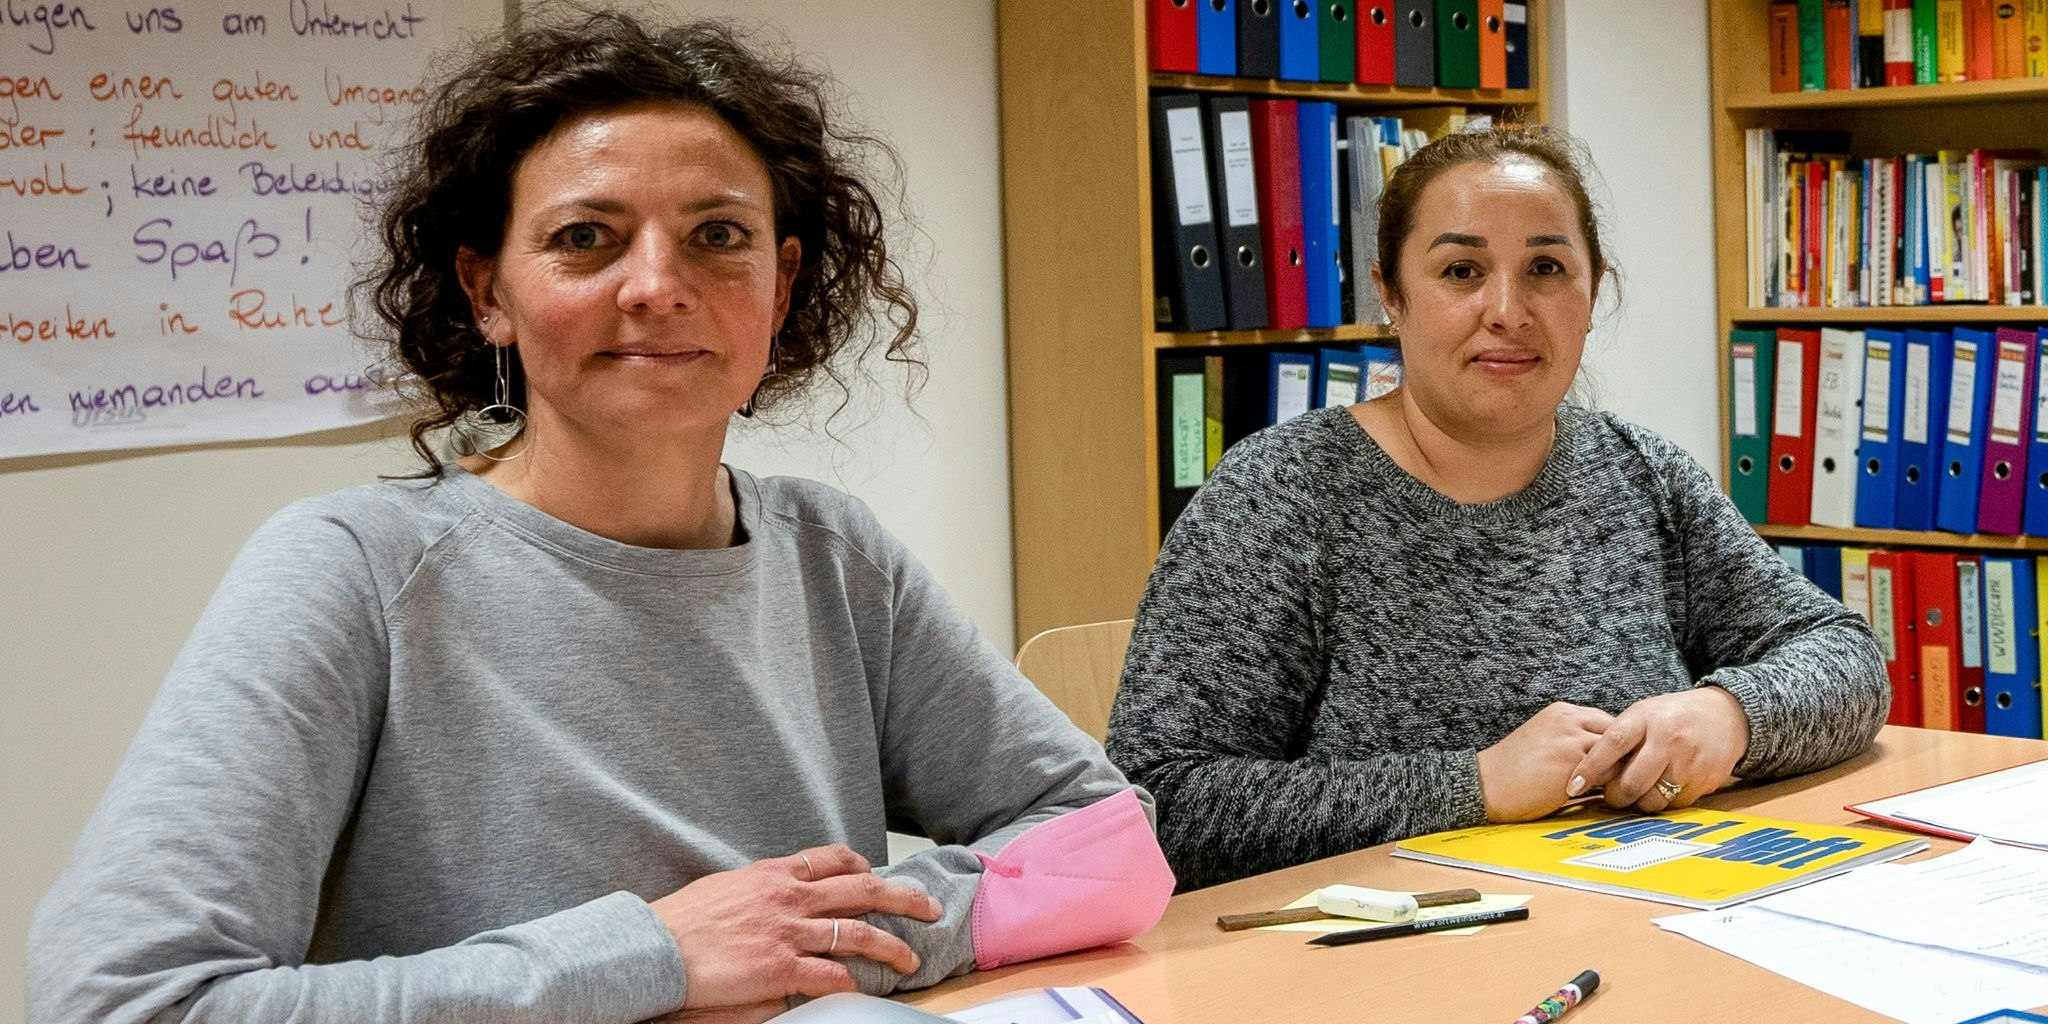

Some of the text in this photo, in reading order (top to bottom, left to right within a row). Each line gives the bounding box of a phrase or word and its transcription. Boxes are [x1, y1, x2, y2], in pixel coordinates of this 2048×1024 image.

[0, 0, 425, 54] ligen uns am Unterricht
[89, 71, 183, 101] einen
[212, 71, 299, 126] guten
[122, 103, 277, 160] freundlich
[308, 120, 371, 151] und
[0, 162, 88, 196] voll
[131, 163, 218, 199] keine
[0, 231, 90, 271] ben
[0, 288, 345, 343] beiten in Ruhe
[0, 392, 40, 420] en
[69, 364, 265, 413] niemanden
